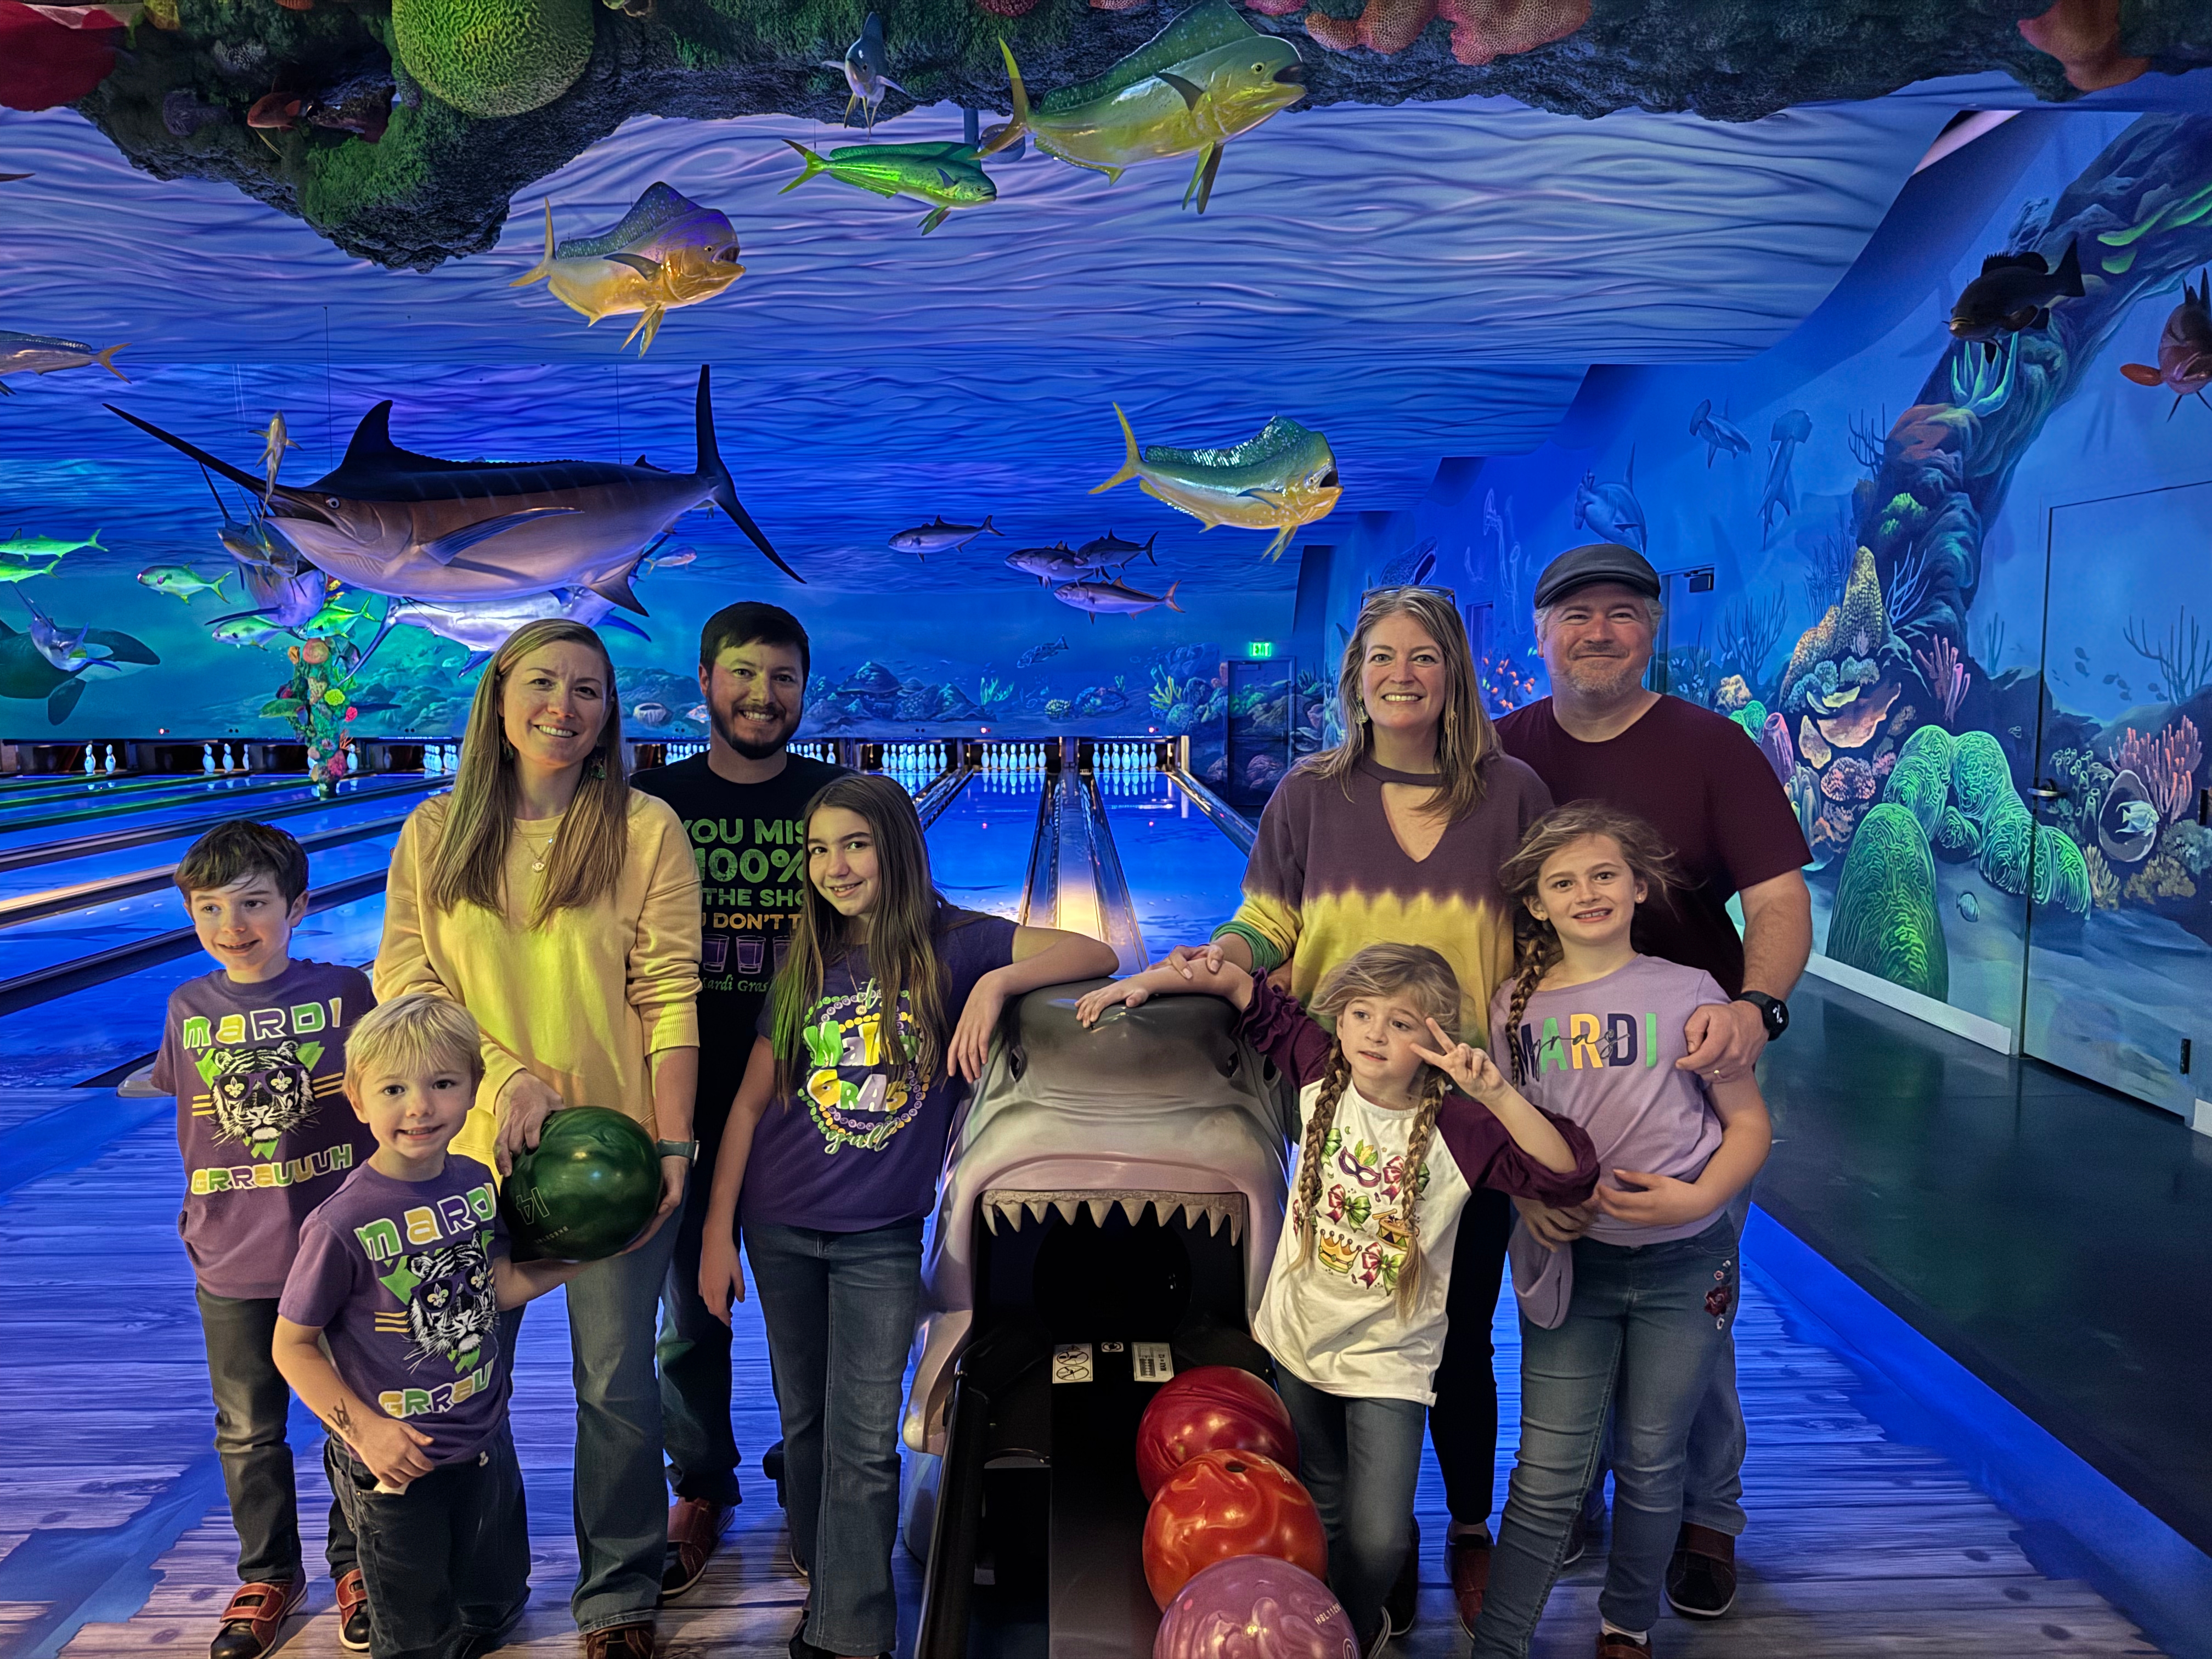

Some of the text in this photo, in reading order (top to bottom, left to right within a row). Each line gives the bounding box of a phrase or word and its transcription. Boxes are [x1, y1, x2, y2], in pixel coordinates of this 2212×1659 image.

[1253, 642, 1269, 656] EXIT
[702, 888, 752, 906] THE
[714, 912, 784, 930] DON'T
[703, 974, 768, 992] ardi Gras
[516, 1187, 550, 1225] 14
